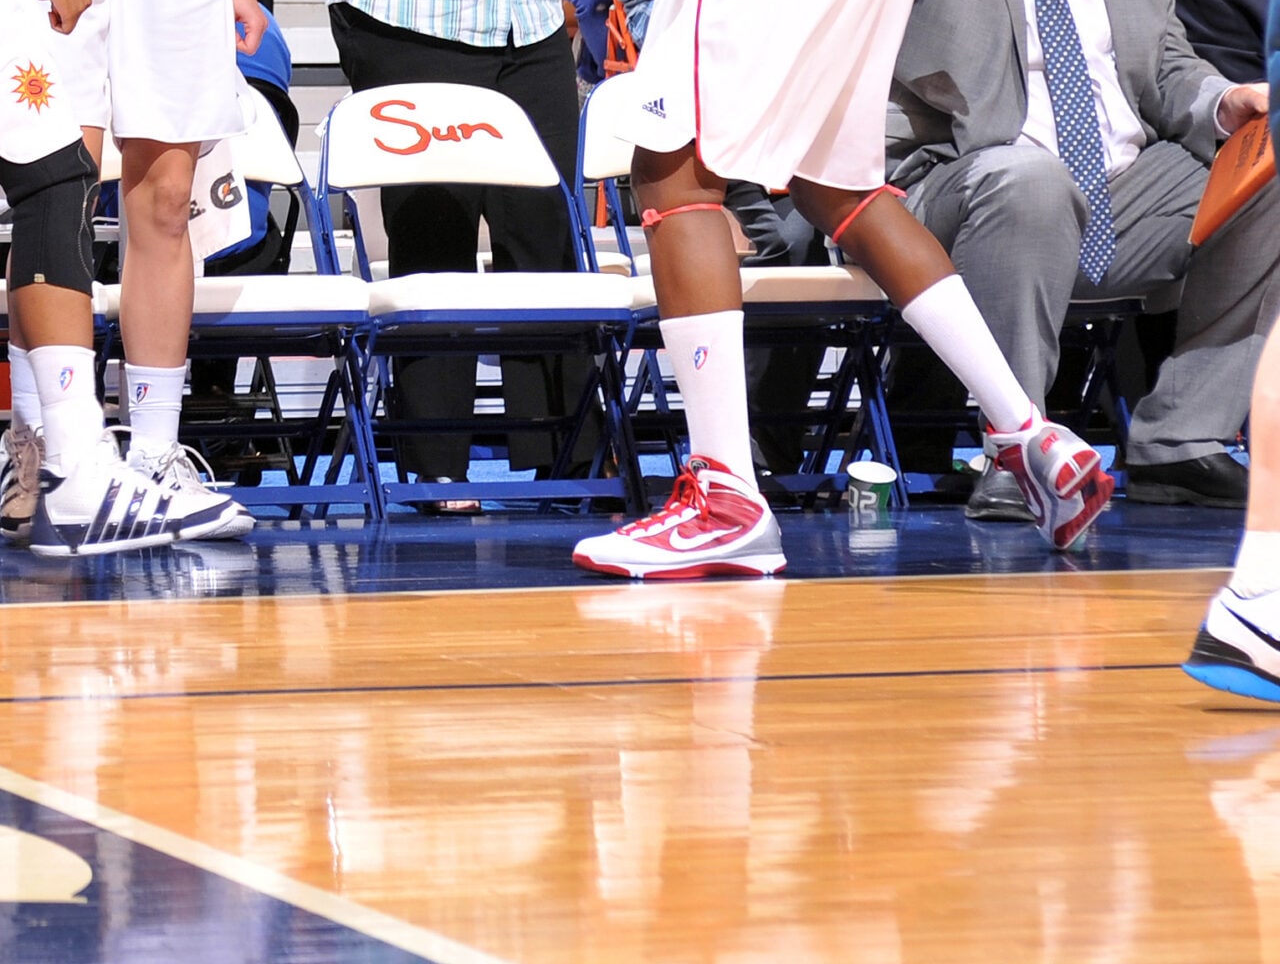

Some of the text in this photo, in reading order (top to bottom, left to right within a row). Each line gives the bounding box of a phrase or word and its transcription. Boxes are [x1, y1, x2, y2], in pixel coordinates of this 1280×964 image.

[28, 79, 43, 94] S
[370, 100, 503, 155] Sun
[210, 172, 243, 209] G
